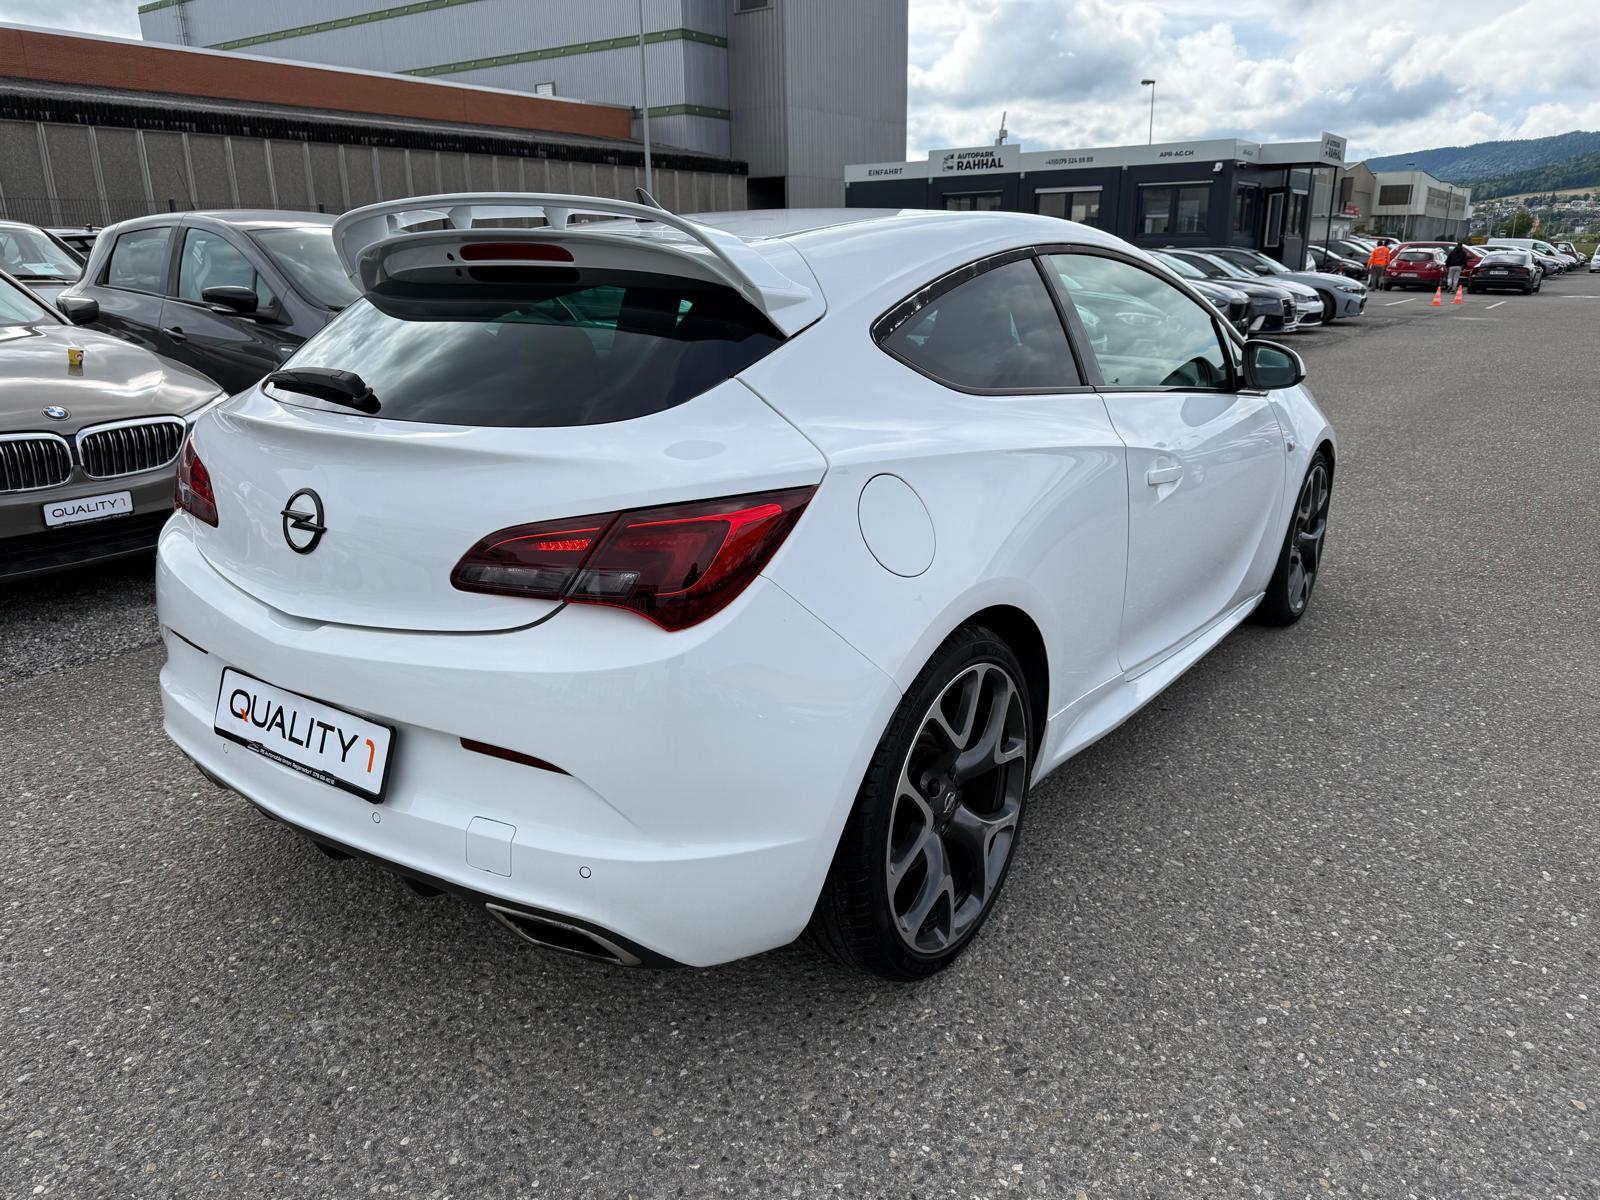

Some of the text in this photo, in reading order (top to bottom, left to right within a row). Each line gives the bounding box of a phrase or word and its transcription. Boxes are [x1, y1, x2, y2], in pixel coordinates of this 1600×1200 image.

[957, 151, 994, 160] AUTOPARK
[956, 158, 1004, 171] RAHHAL
[868, 168, 903, 176] EINFAHRT
[52, 499, 117, 518] QUALITY
[229, 688, 375, 773] QUALITY 1
